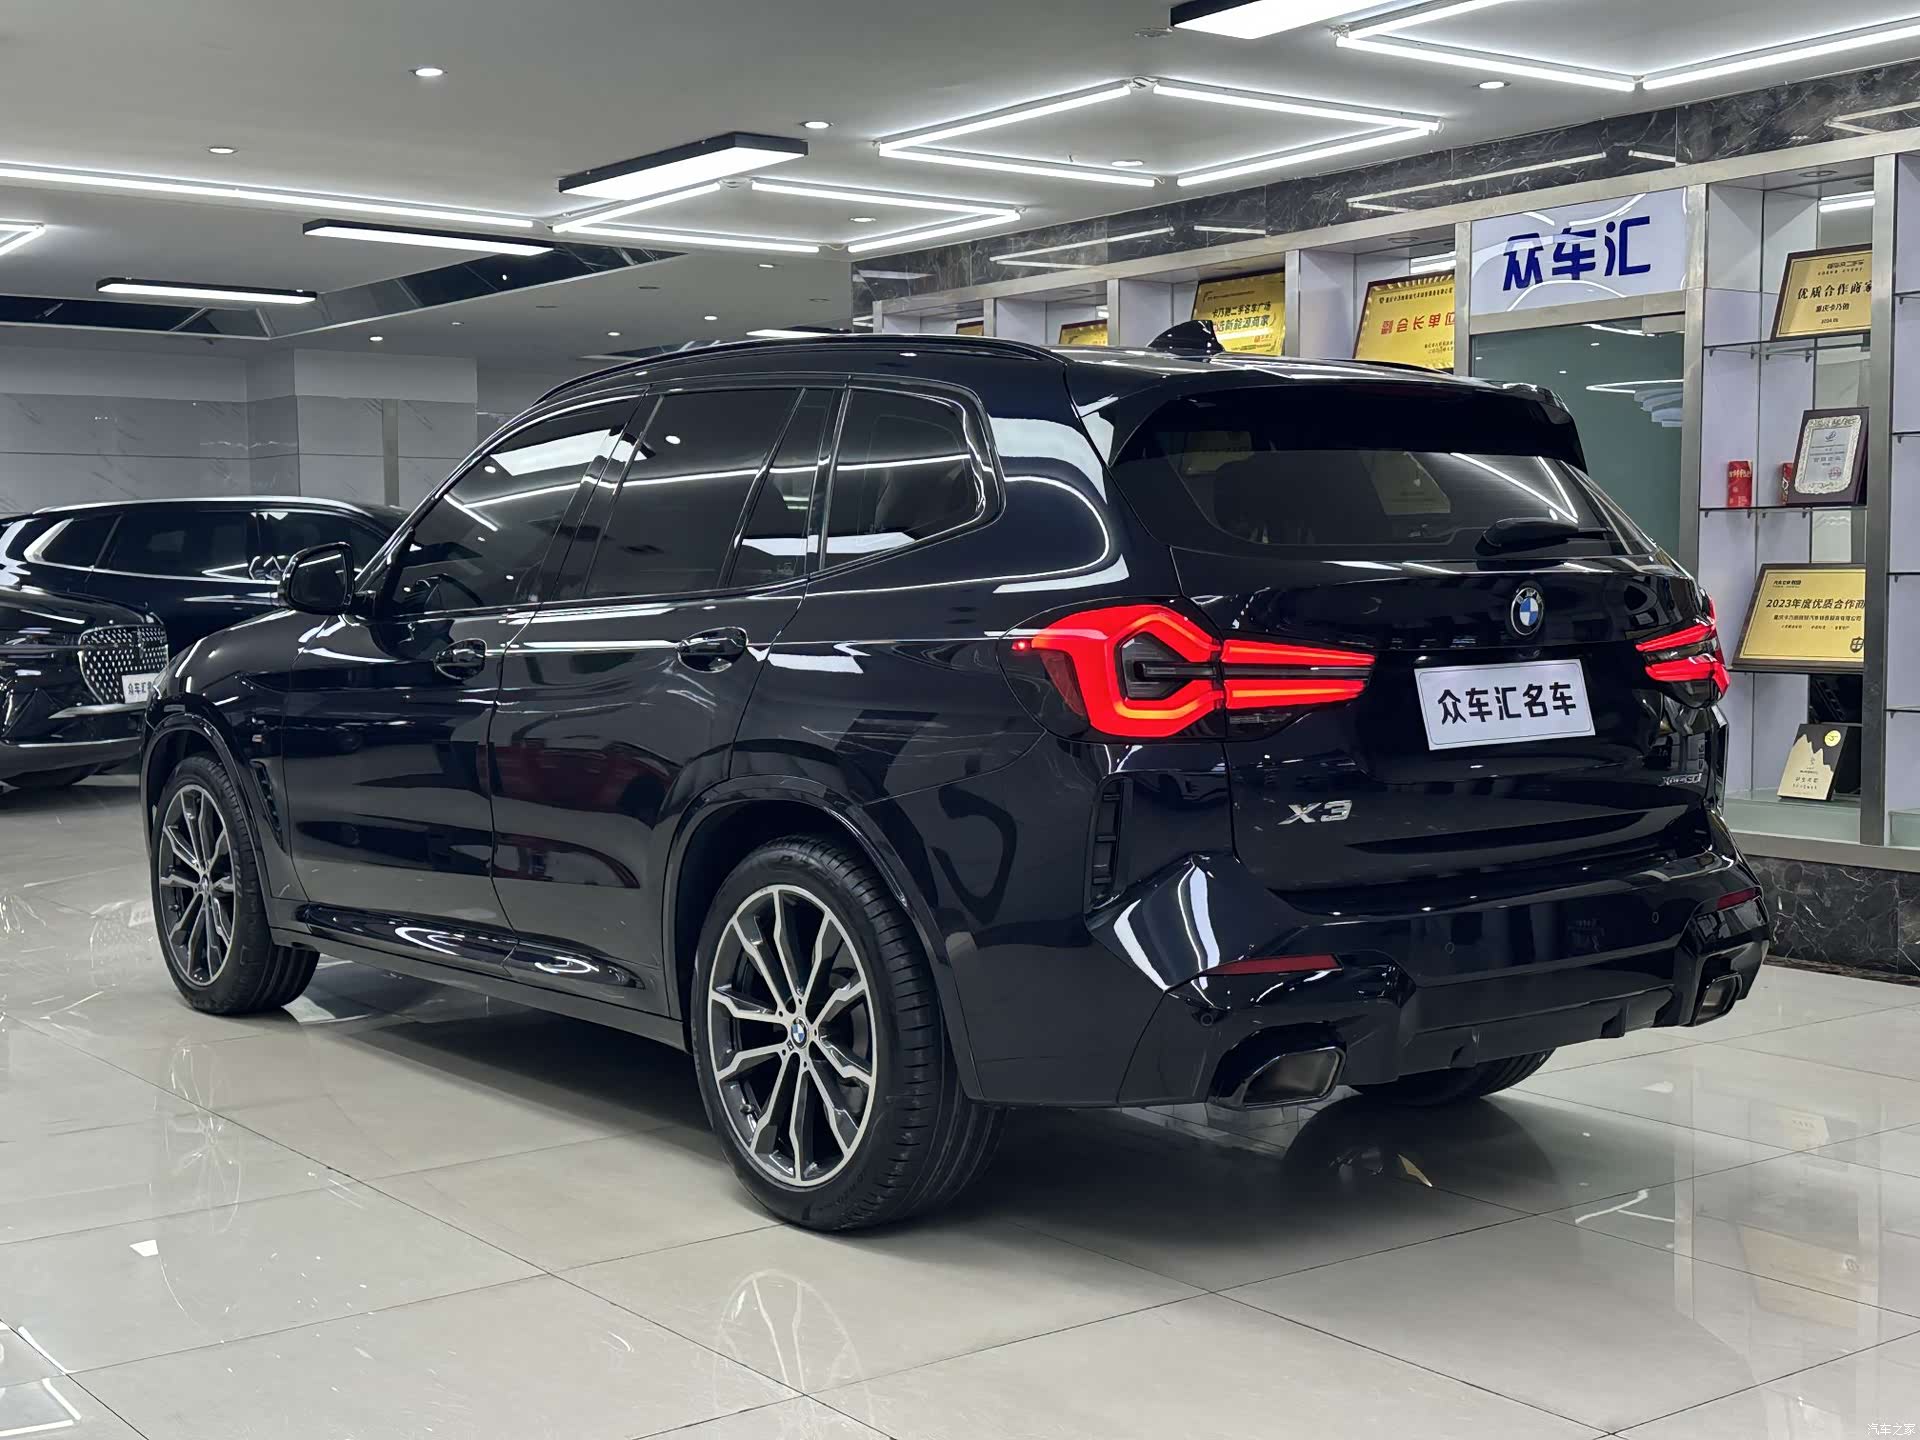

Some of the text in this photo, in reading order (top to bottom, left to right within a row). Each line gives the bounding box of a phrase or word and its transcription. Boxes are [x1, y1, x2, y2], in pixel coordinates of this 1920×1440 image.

[1502, 215, 1651, 291] 众车汇
[1437, 681, 1577, 725] 众车汇名车
[1277, 800, 1353, 825] X3
